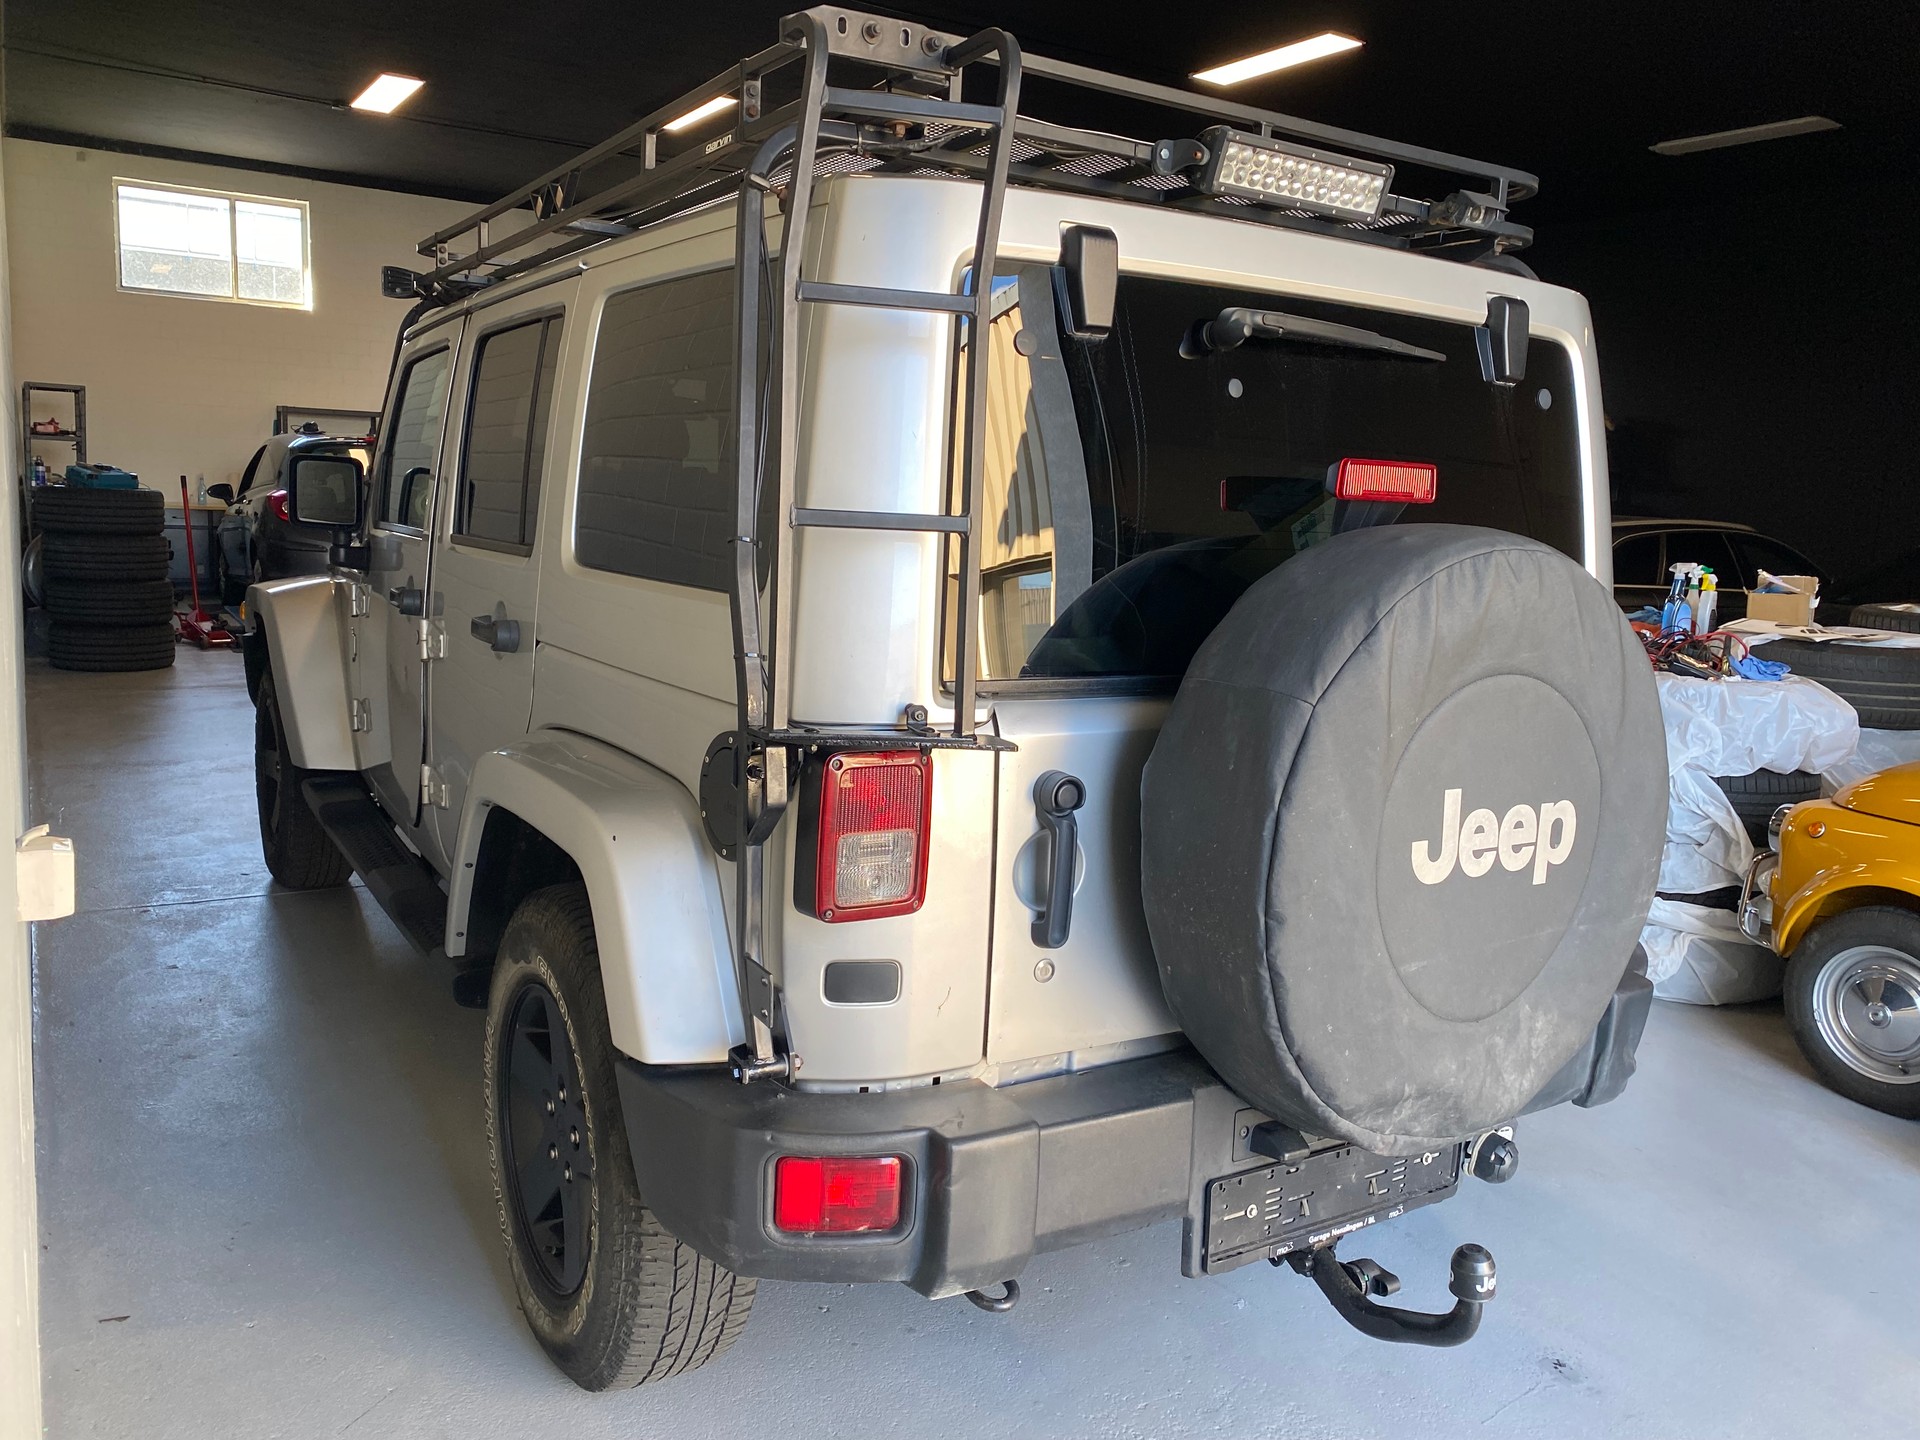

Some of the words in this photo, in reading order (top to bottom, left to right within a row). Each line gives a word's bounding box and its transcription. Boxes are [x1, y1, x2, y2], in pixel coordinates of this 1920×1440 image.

[705, 134, 732, 155] garvin
[1411, 788, 1577, 885] Jeep
[483, 1016, 513, 1258] YOKOHAMA
[1308, 1232, 1330, 1244] Garage
